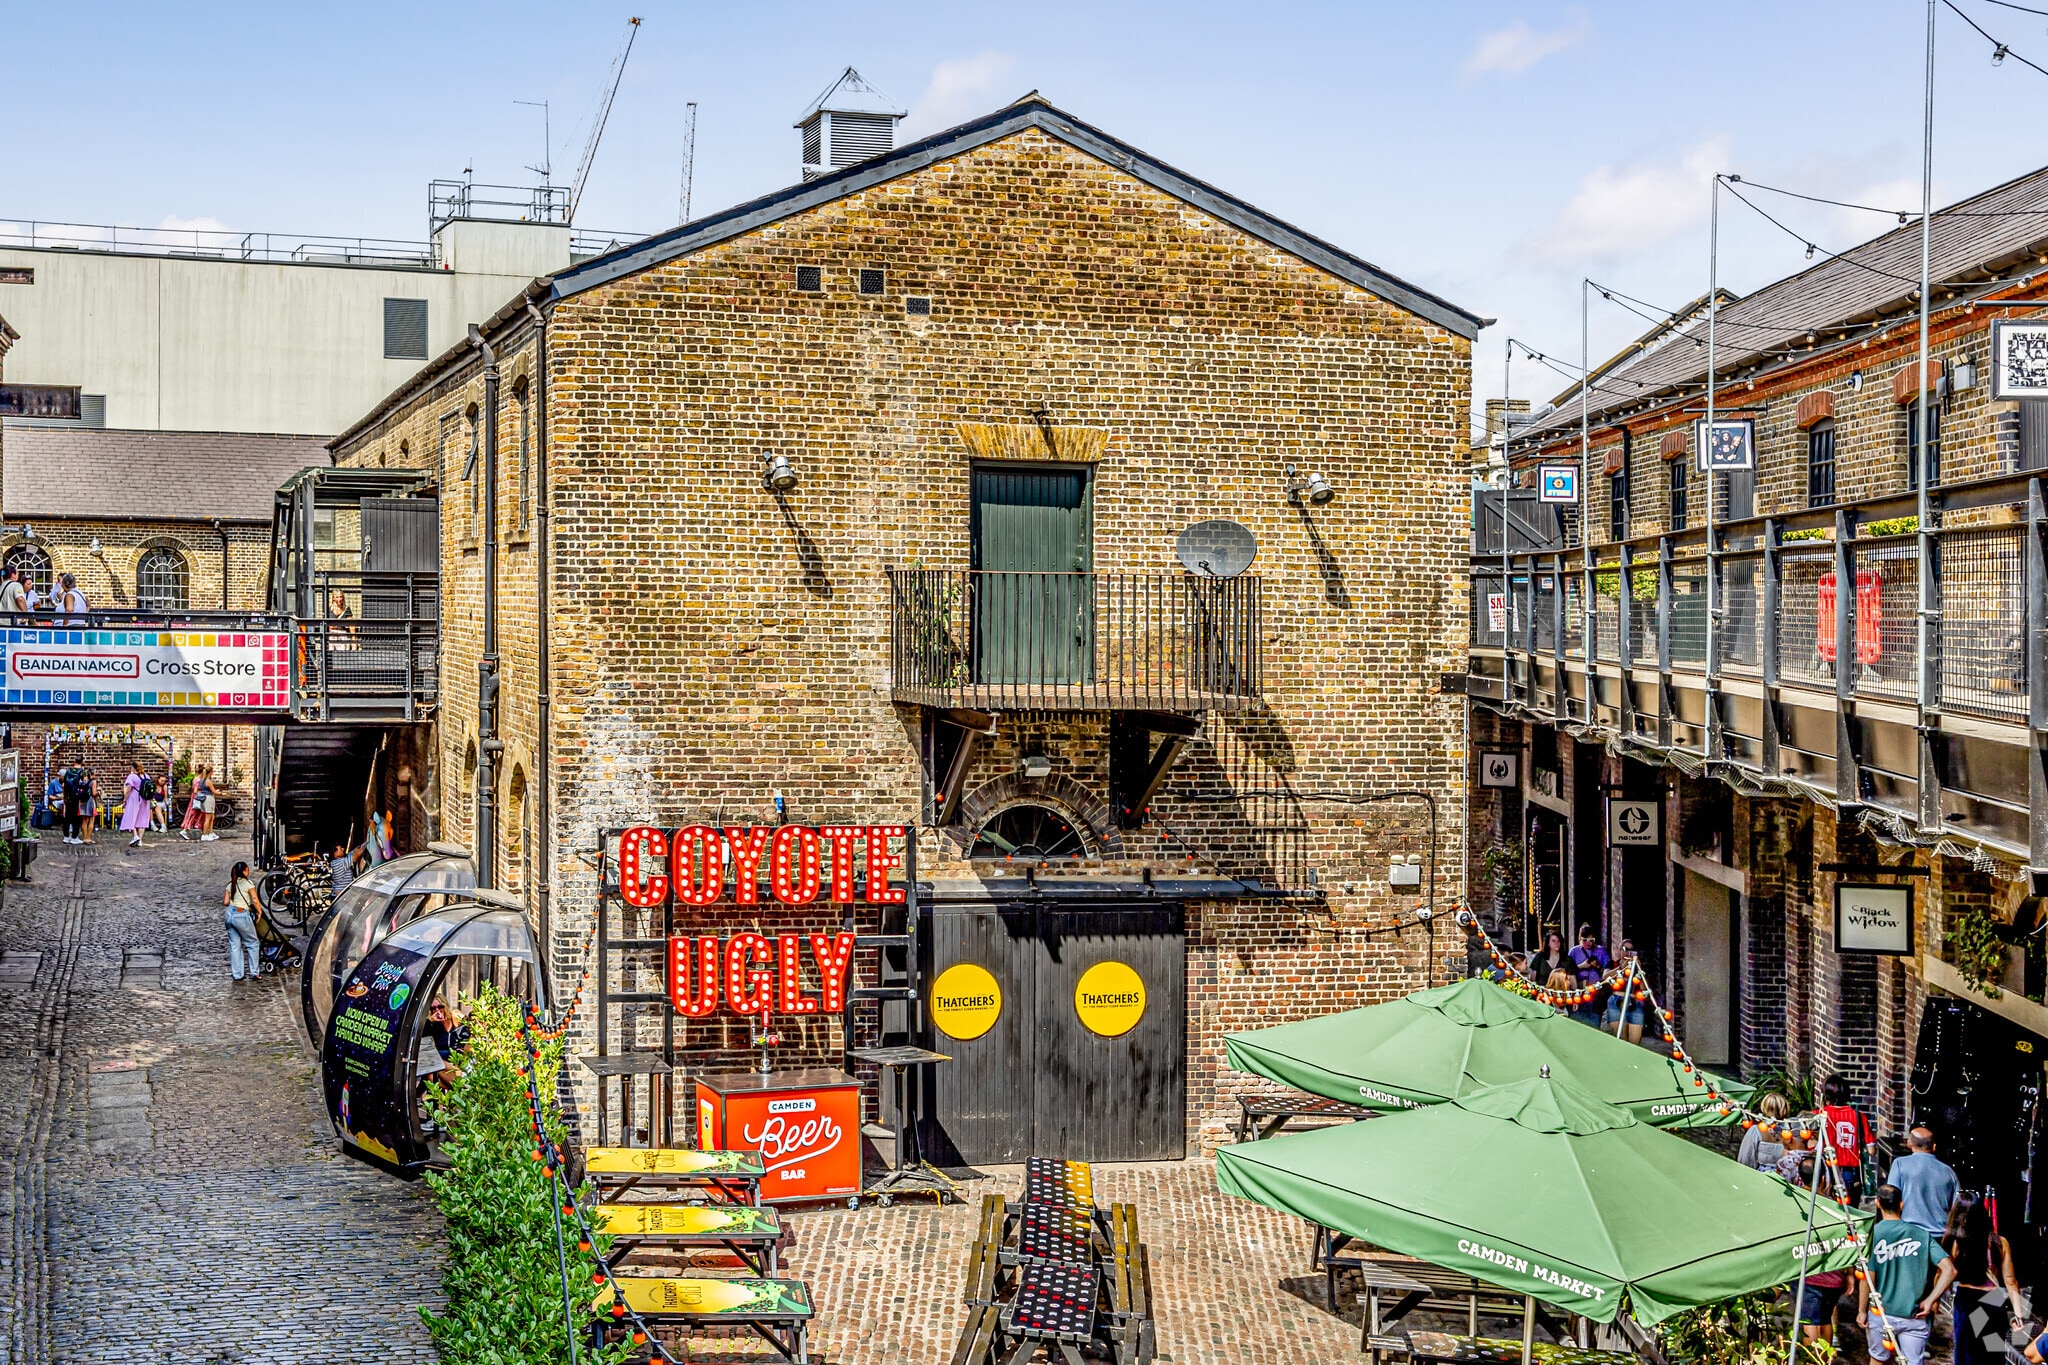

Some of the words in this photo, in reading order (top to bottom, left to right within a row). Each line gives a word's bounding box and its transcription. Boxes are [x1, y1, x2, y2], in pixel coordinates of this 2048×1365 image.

[20, 659, 75, 671] BANDAI
[78, 661, 133, 672] NAMCO
[146, 659, 200, 676] Cross
[203, 660, 256, 676] Store
[619, 824, 907, 907] COYOTE
[1852, 905, 1892, 917] Black
[1848, 916, 1900, 929] Widow
[670, 932, 856, 1017] UGLY
[936, 994, 995, 1008] THATCHERS
[1082, 992, 1139, 1004] THATCHERS
[345, 1007, 362, 1020] NOW
[362, 1010, 380, 1027] OPEN
[379, 1017, 389, 1030] IN
[335, 1015, 363, 1033] CAMDEN
[363, 1023, 393, 1044] MARKET
[335, 1026, 362, 1045] HAWLEY
[361, 1036, 387, 1054] WHARF
[771, 1101, 812, 1111] CAMDEN
[1359, 1086, 1400, 1106] CAMDEN
[1651, 1103, 1697, 1116] CAMDEN
[744, 1115, 842, 1160] Beer
[1836, 1121, 1855, 1149] 6
[781, 1168, 806, 1181] BAR
[1457, 1239, 1529, 1274] CAMDEN
[1532, 1264, 1606, 1302] MARKET
[662, 1281, 678, 1309] THATCHERS
[680, 1286, 703, 1305] Gold
